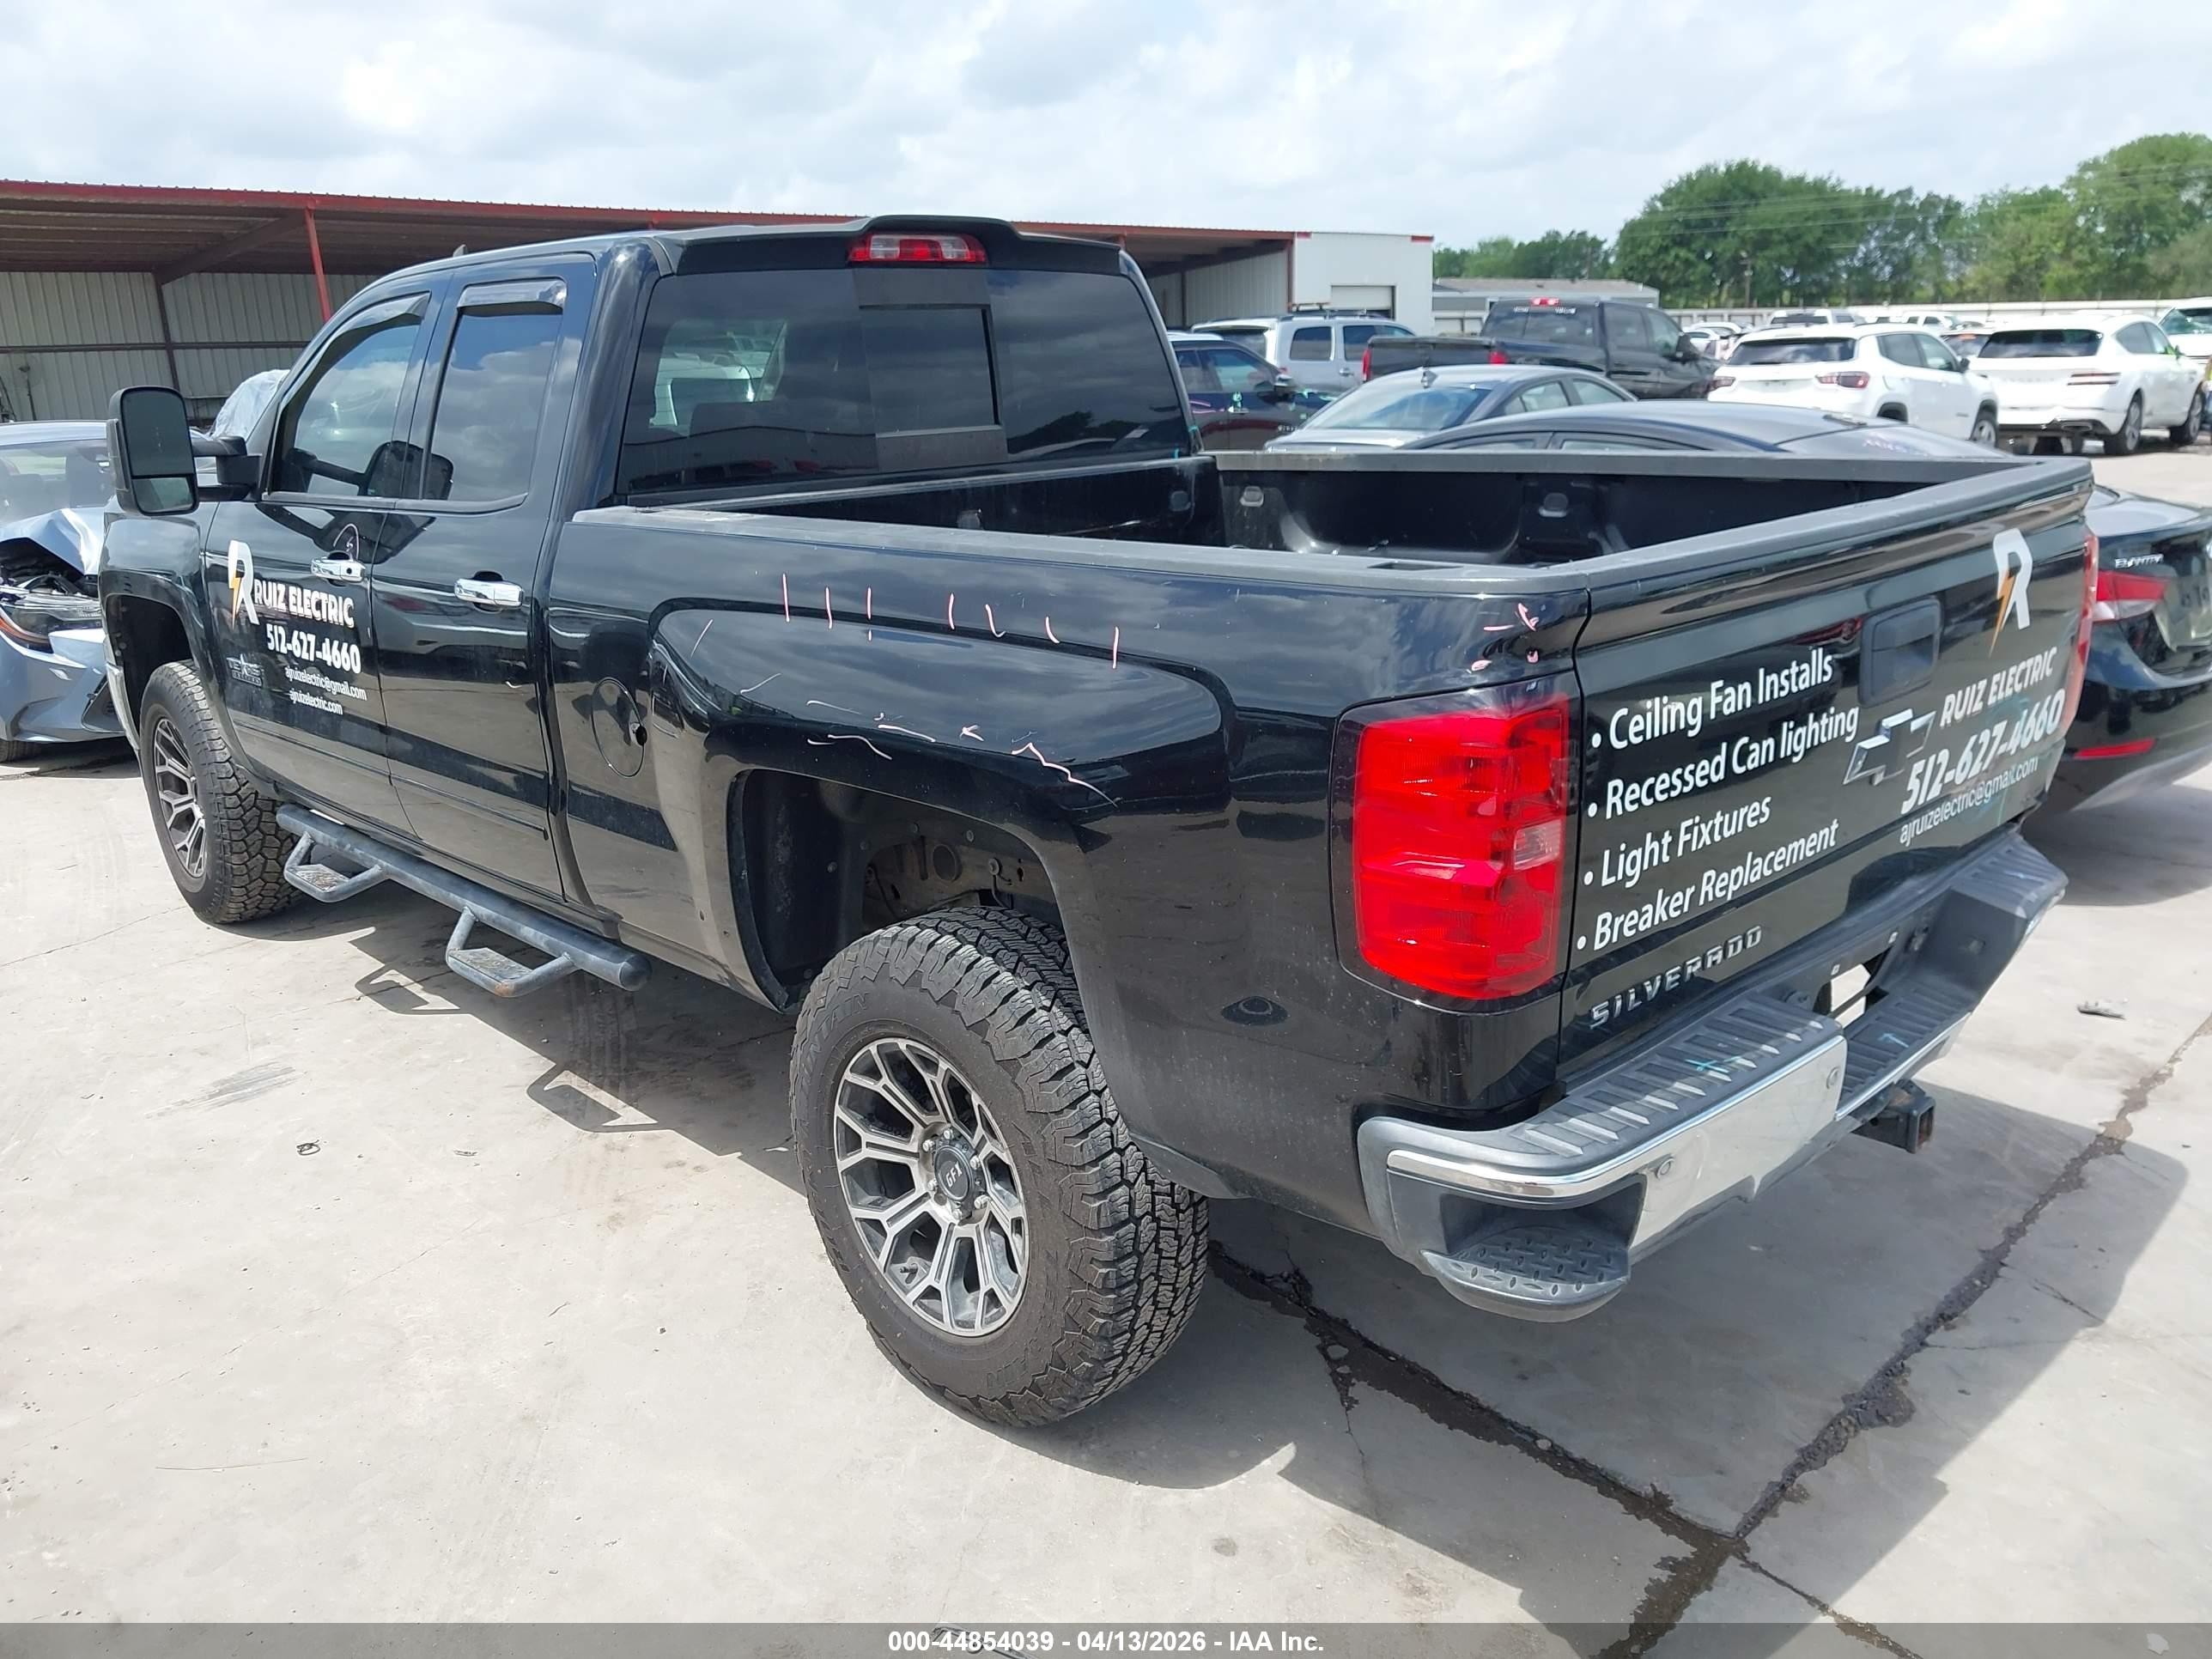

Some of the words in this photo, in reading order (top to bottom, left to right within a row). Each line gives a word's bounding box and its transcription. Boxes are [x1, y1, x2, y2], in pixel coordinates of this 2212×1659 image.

[254, 579, 287, 611] RUIZ
[289, 586, 355, 628] ELECTRIC
[266, 623, 362, 674] 512-627-4660
[1608, 695, 1703, 750] Ceiling
[1710, 680, 1751, 720] Fan
[1758, 647, 1832, 704] Installs
[1940, 678, 1988, 727] RUIZ
[1988, 647, 2057, 706] ELECTRIC
[1606, 742, 1728, 819] Recessed
[1732, 737, 1774, 775] Can
[1780, 706, 1859, 763] lighting
[1900, 689, 2065, 815] 512-627-4660
[1601, 831, 1673, 888] Light
[1677, 797, 1771, 857] Fixtures
[1899, 757, 2039, 847] ajruizelectric@gmail.com
[1594, 889, 1695, 951] Breaker
[1698, 818, 1839, 906] Replacement
[1589, 926, 1762, 1030] SILVERADO
[945, 1161, 962, 1188] GFX
